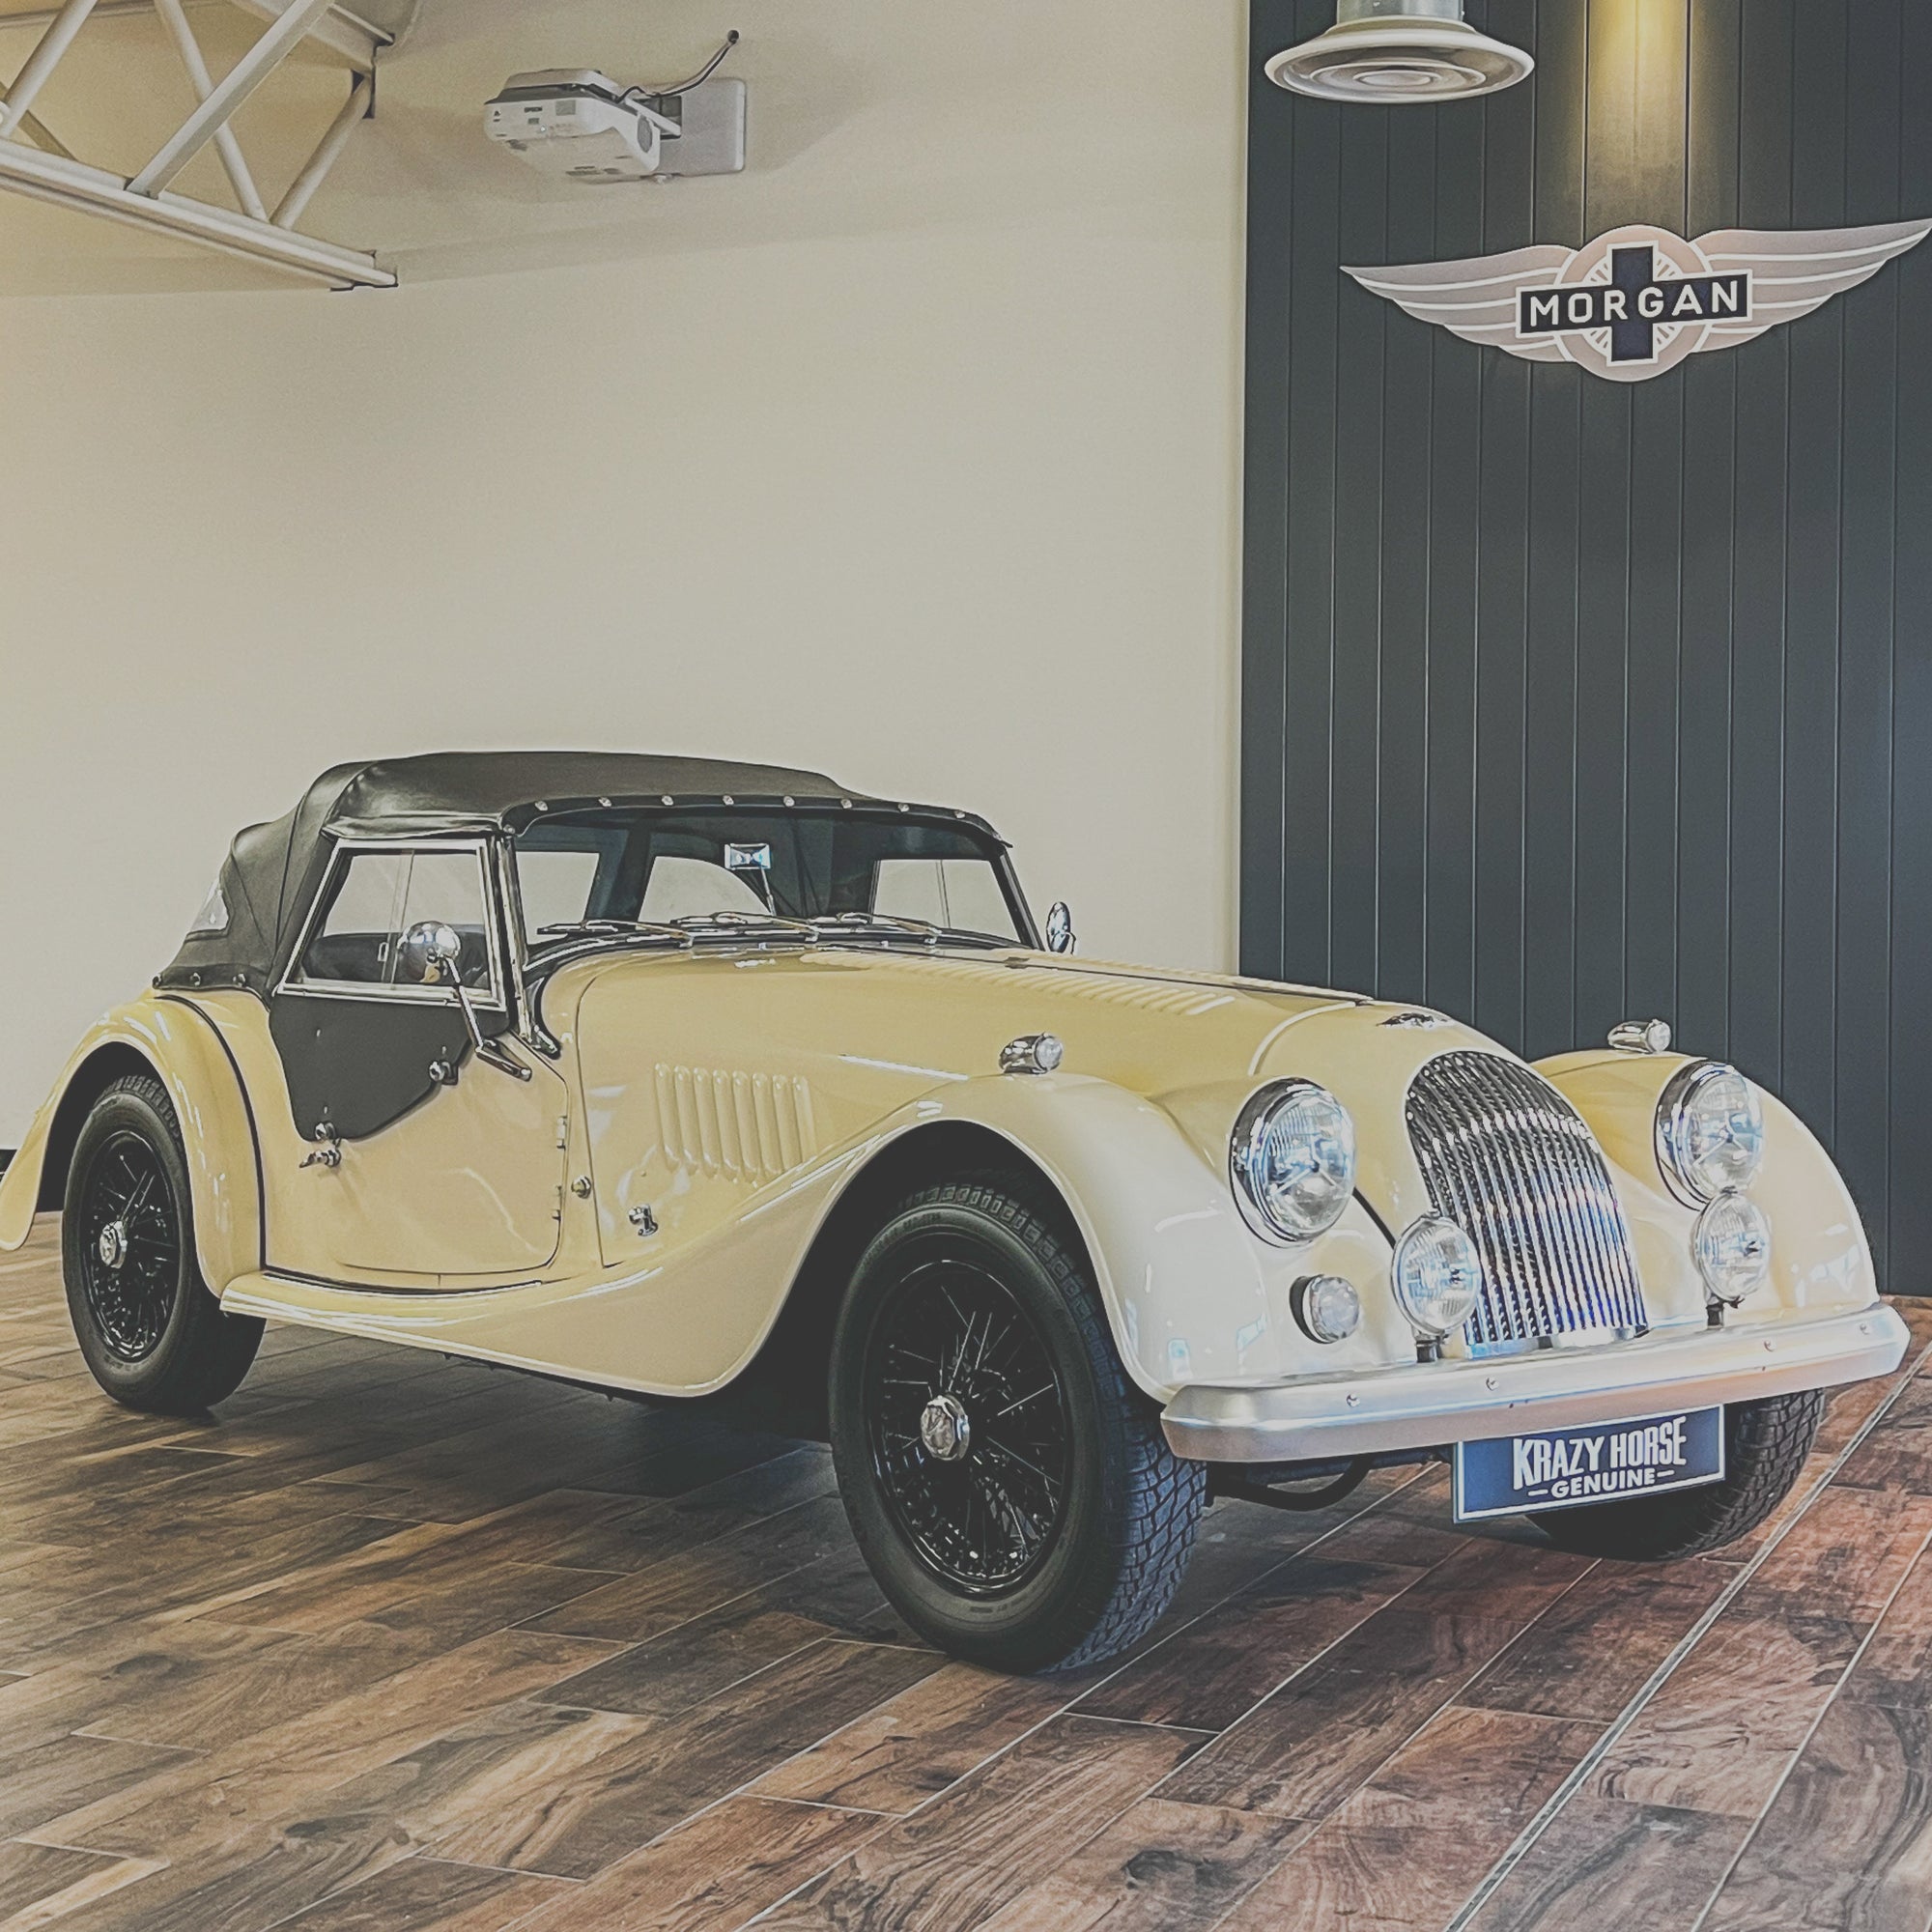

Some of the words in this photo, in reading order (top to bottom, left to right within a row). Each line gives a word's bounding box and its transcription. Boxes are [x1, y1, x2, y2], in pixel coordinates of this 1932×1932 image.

[1530, 280, 1739, 327] MORGAN
[1513, 1437, 1605, 1491] KRAZY
[1609, 1416, 1687, 1468] HORSE
